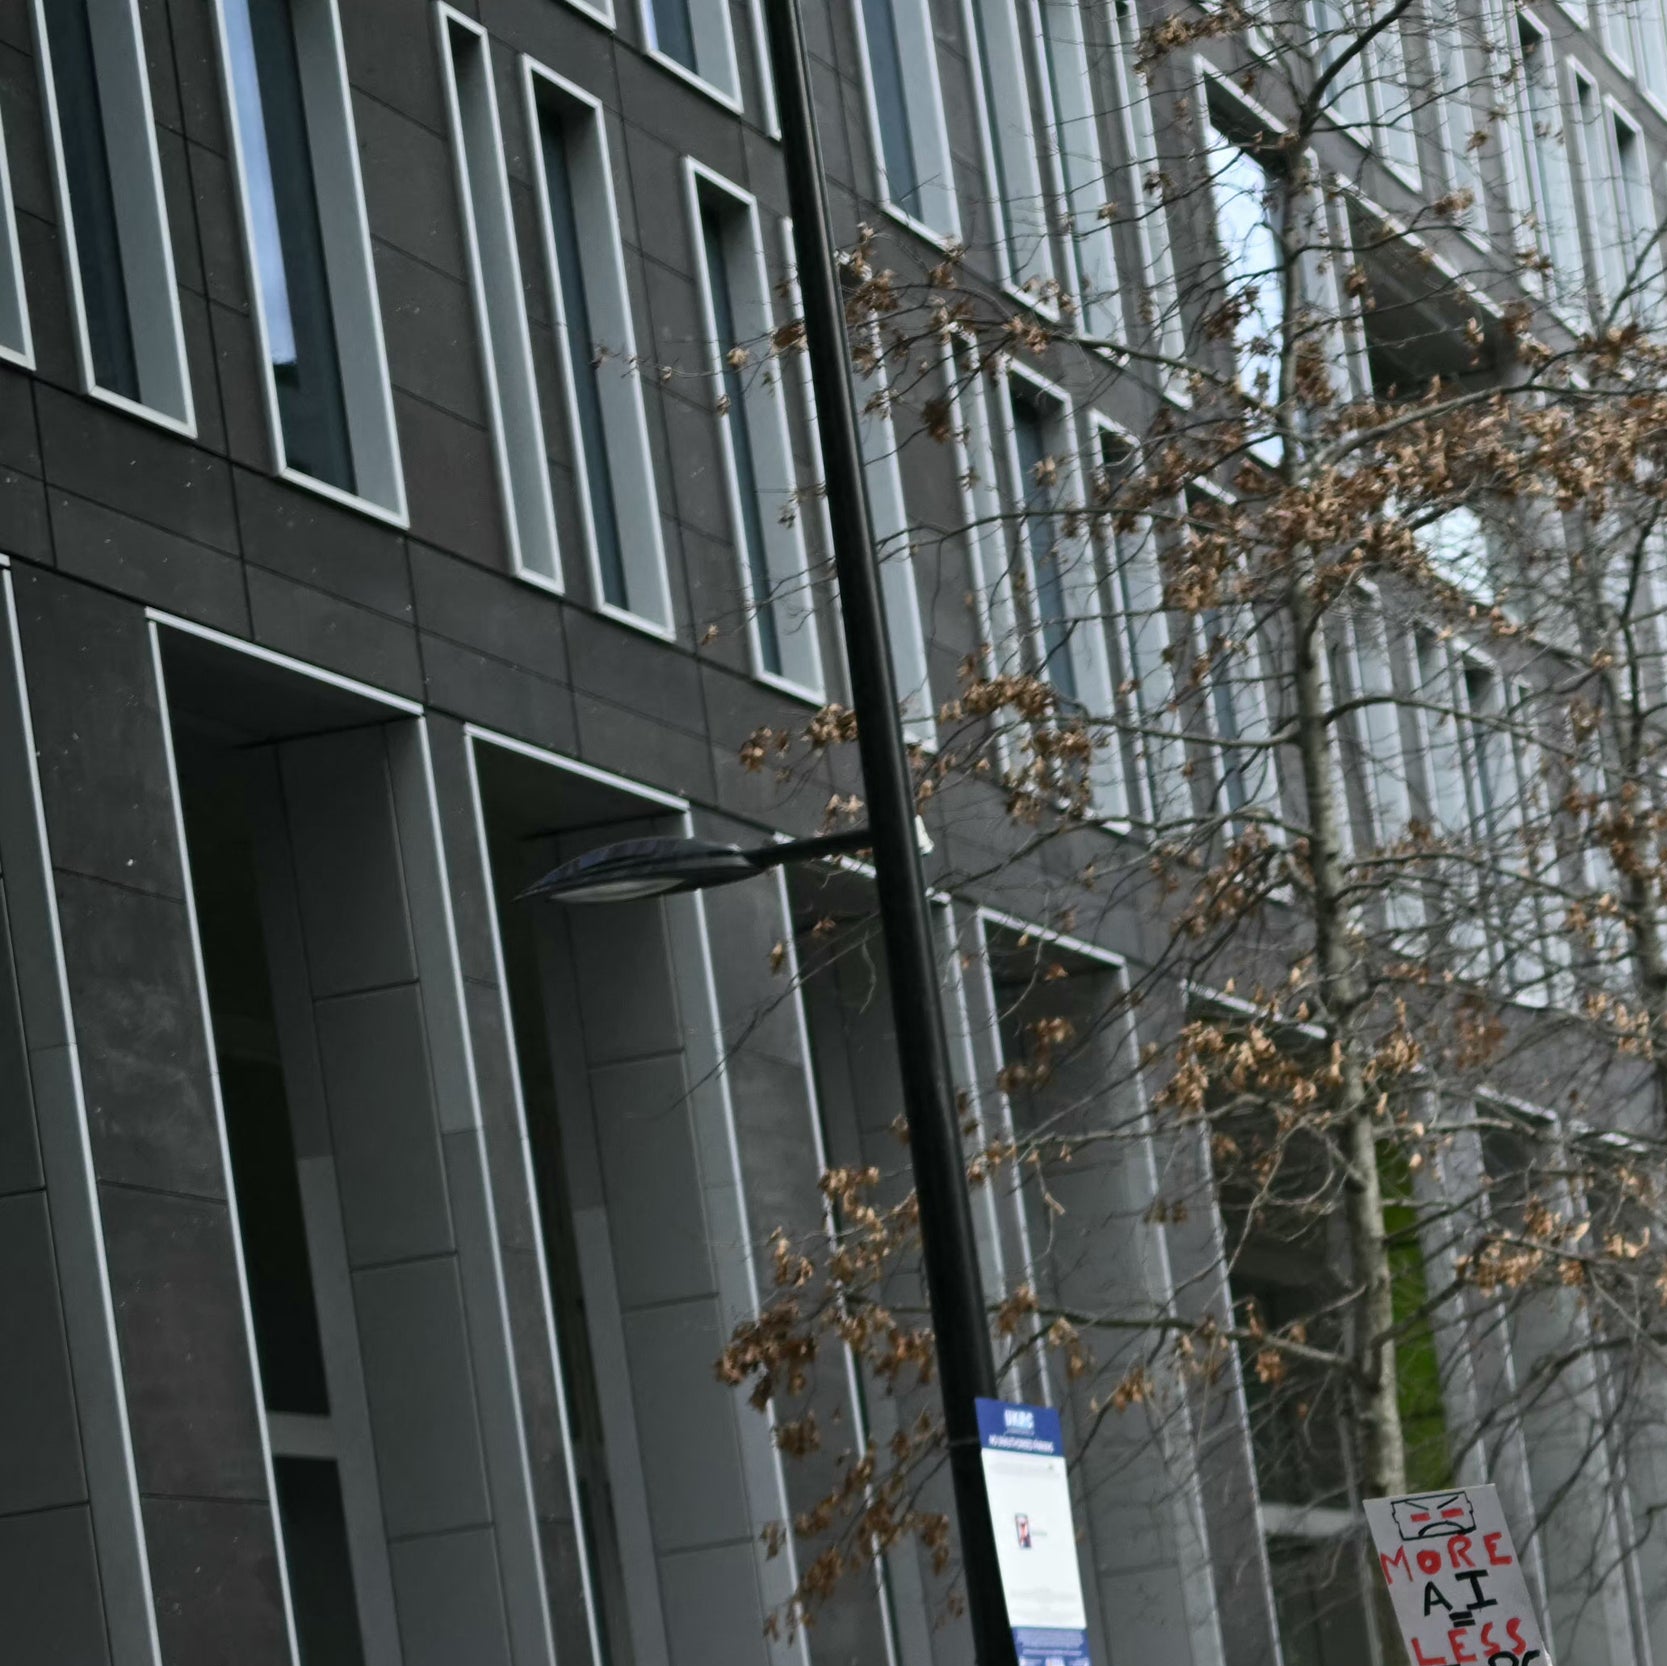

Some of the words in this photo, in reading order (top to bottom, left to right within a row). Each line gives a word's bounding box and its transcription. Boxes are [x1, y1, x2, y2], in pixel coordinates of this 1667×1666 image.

[1380, 1531, 1513, 1585] MORE
[1424, 1569, 1498, 1616] AI
[1411, 1617, 1527, 1666] LESS
